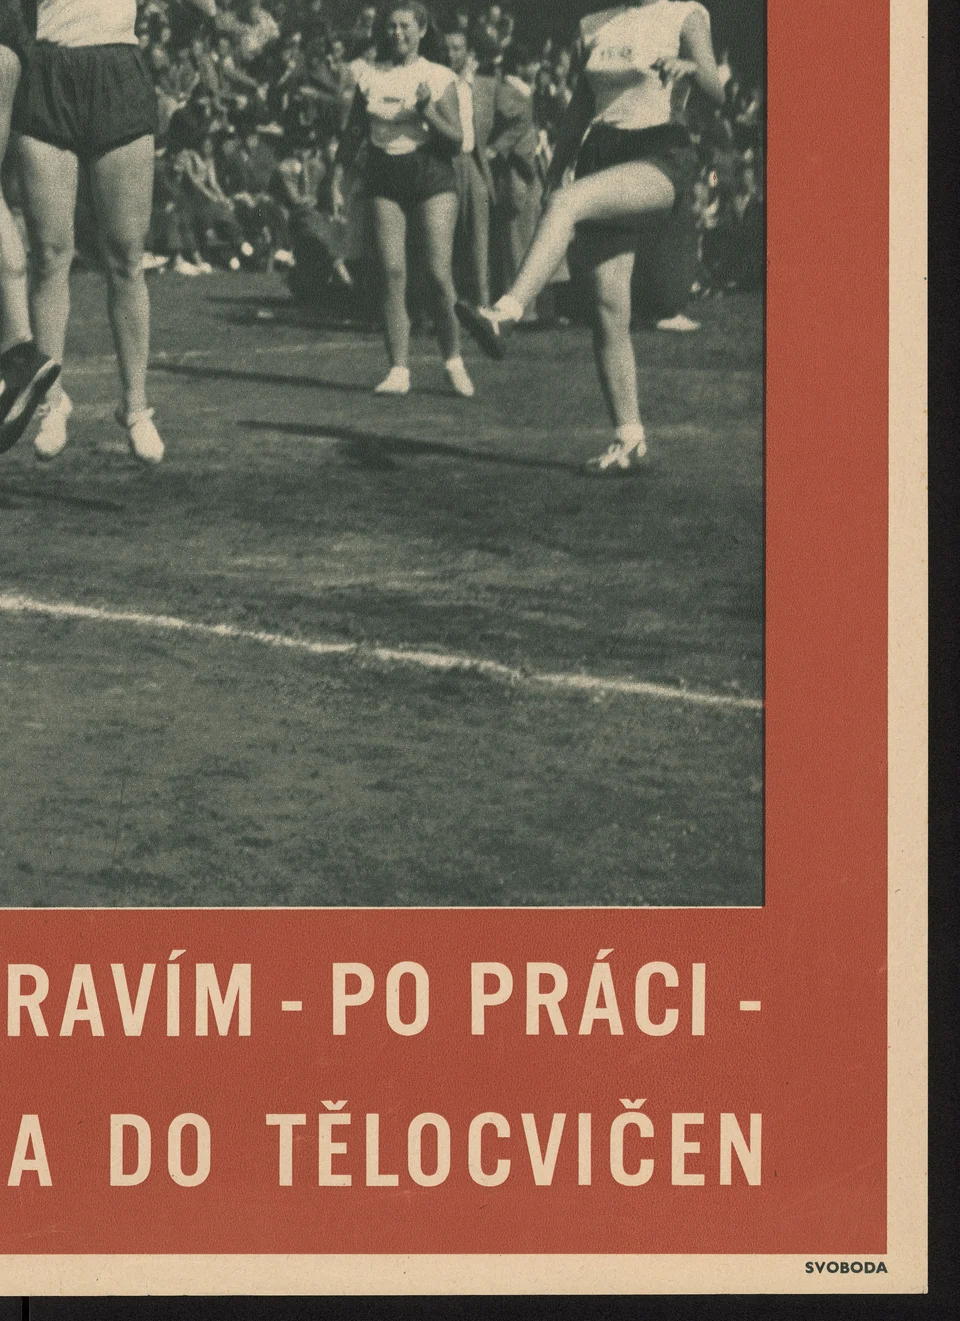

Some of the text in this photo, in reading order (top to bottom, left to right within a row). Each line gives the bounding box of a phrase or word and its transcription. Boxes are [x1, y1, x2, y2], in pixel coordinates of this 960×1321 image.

[332, 961, 430, 1037] PO
[471, 947, 706, 1037] PRÁCI
[7, 1114, 53, 1187] A
[110, 1112, 211, 1188] DO
[265, 1098, 762, 1187] TĚLOCVIČEN
[805, 1261, 888, 1274] SVOBODA
